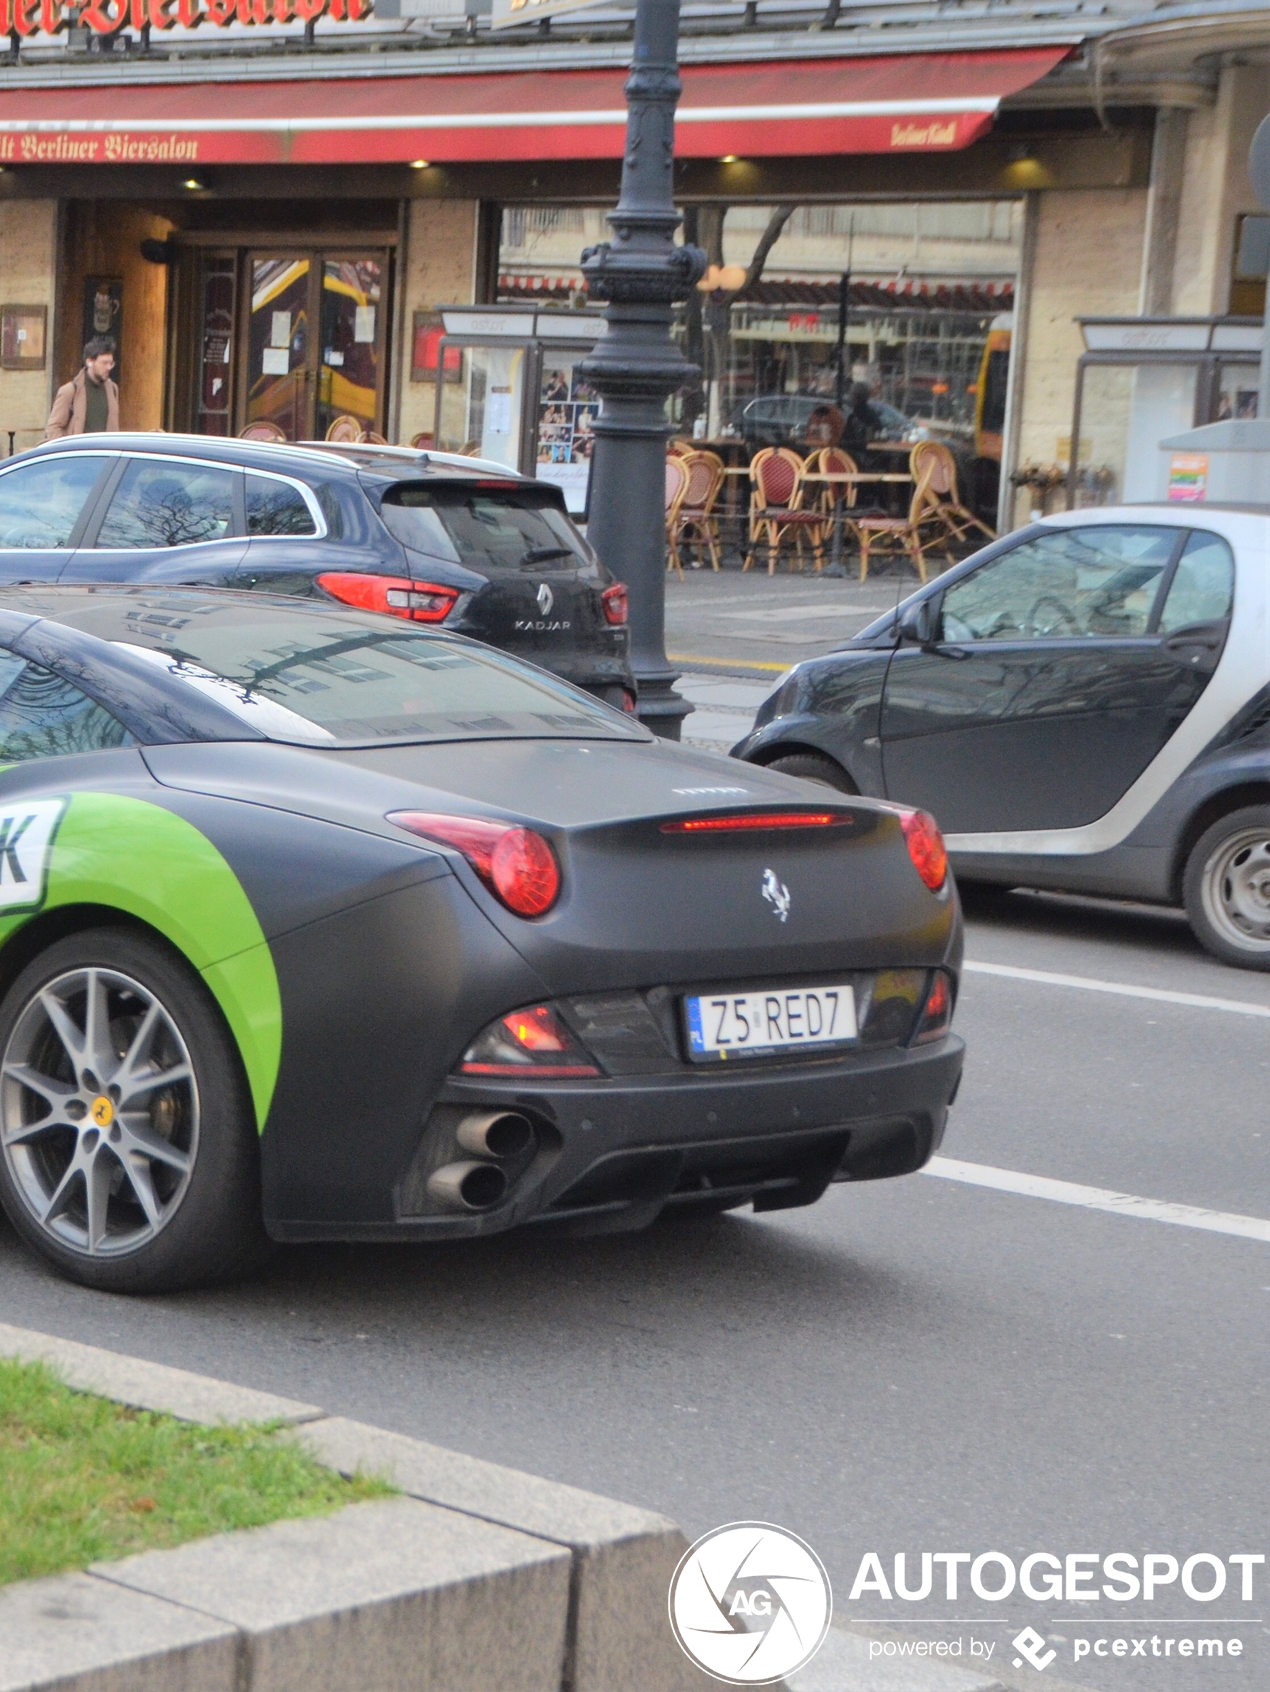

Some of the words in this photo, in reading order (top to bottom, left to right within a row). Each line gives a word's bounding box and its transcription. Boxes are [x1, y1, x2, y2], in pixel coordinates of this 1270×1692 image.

[21, 134, 99, 159] Berliner
[104, 134, 199, 159] Biersalon
[514, 620, 571, 631] KADJAR
[711, 999, 750, 1044] Z5
[765, 992, 839, 1040] RED7
